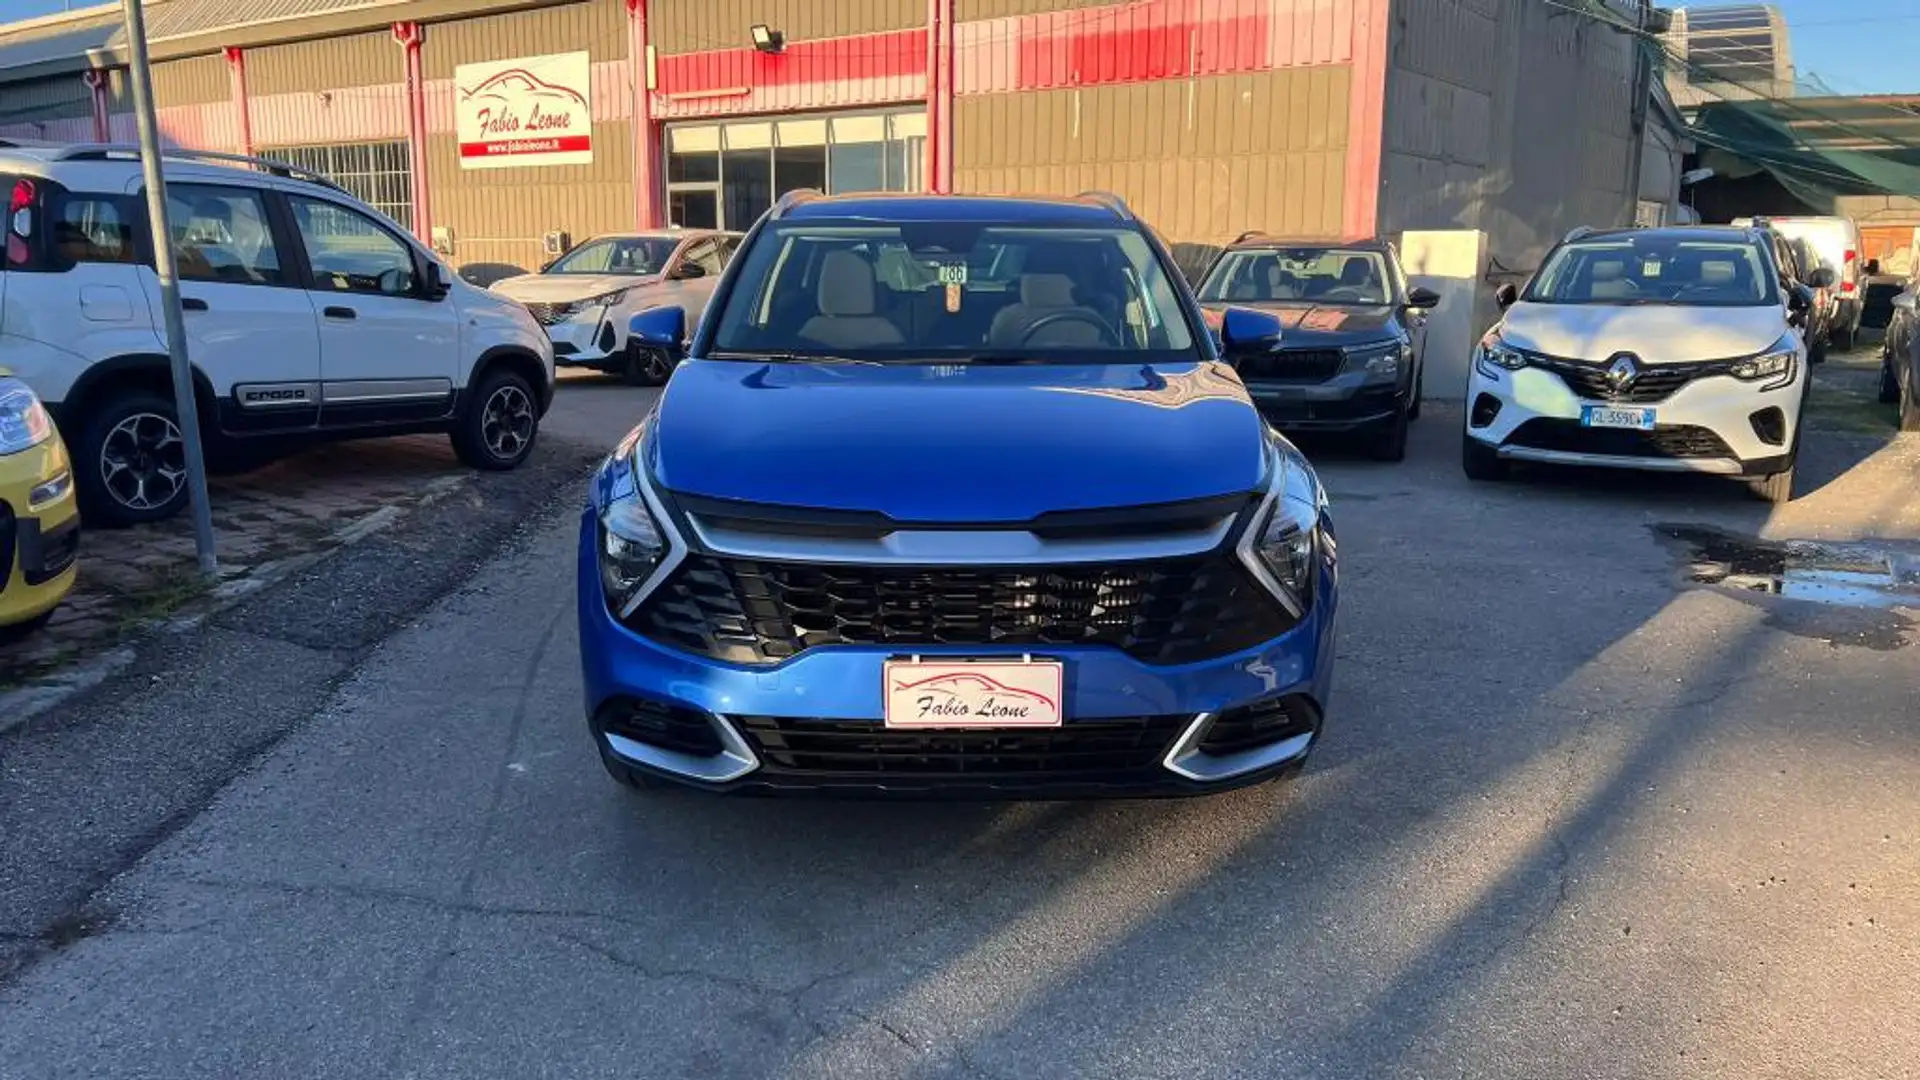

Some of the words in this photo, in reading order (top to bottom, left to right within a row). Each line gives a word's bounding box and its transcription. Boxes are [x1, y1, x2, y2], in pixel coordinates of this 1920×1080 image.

[477, 105, 519, 138] Fabio
[525, 102, 571, 131] Leone
[916, 695, 970, 718] Fabio
[975, 697, 1029, 718] Leone
